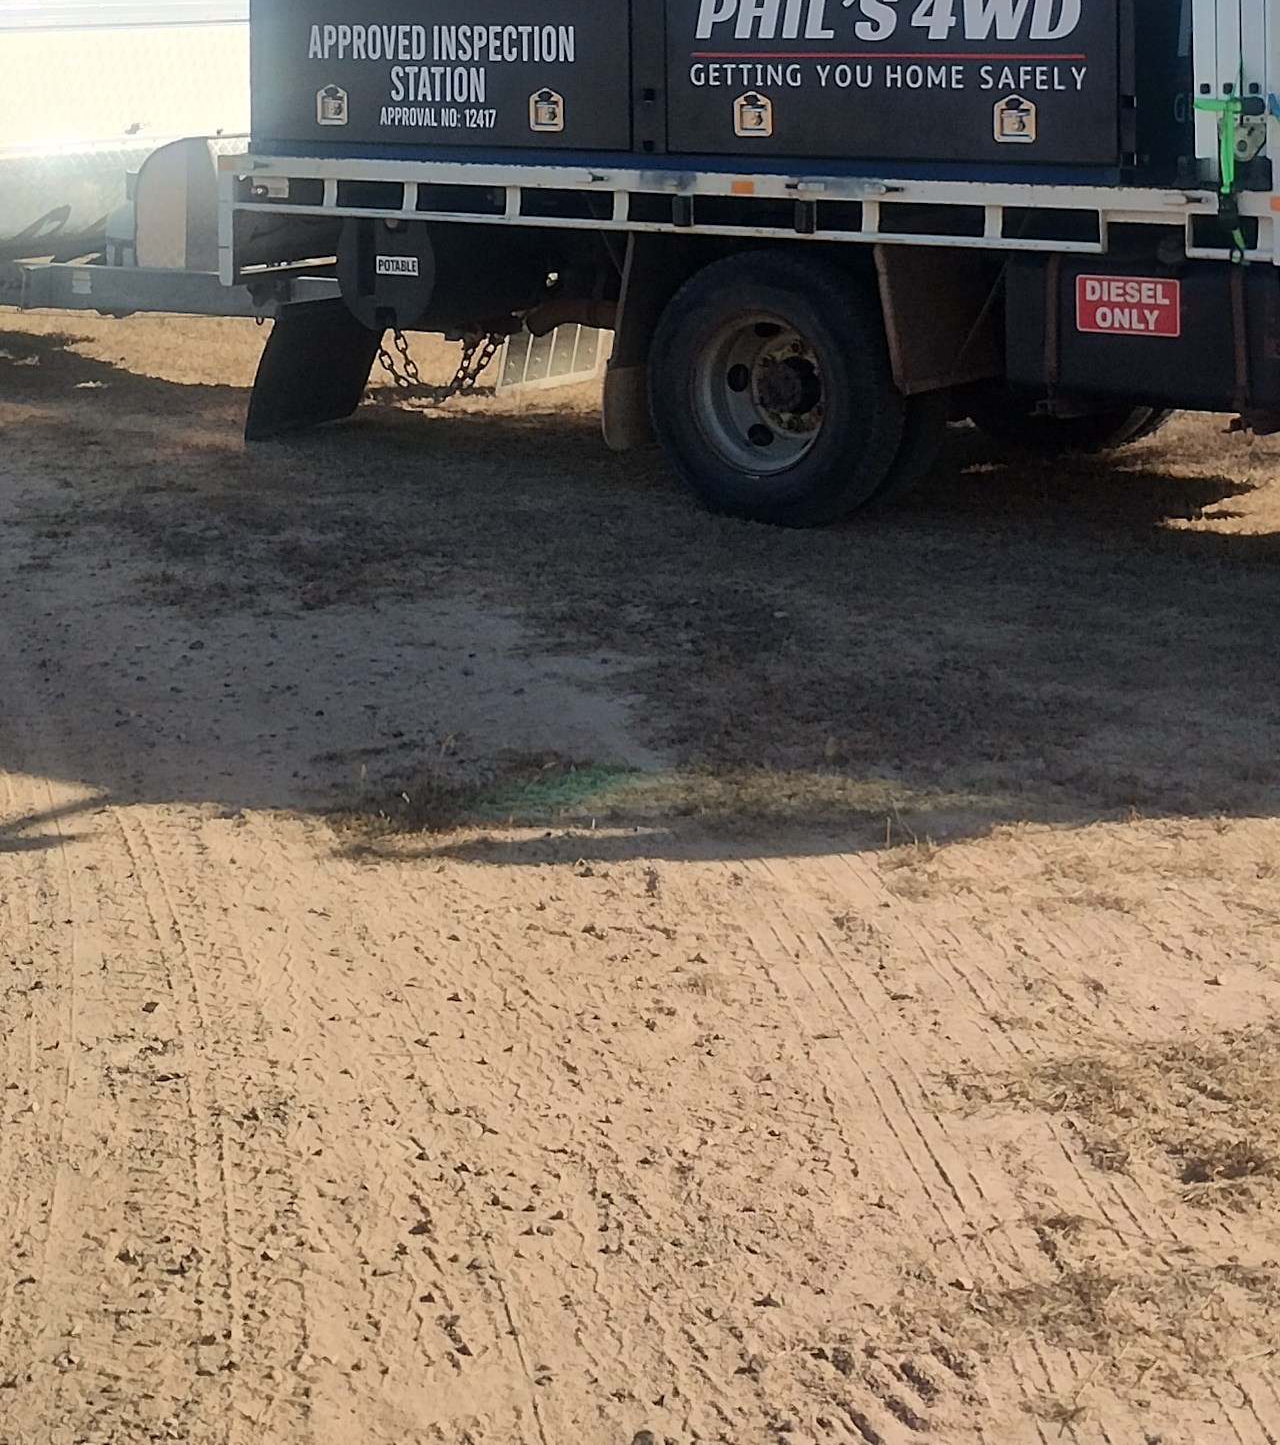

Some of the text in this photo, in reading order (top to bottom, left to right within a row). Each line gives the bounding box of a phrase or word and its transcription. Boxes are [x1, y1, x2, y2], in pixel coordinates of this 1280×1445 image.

[308, 24, 576, 63] APPROVED INSPECTION
[390, 65, 486, 103] STATION
[689, 63, 1088, 91] GETTING YOU HOME SAFELY
[380, 106, 498, 129] APPROVAL NO: 12417
[378, 259, 417, 273] POTABLE
[1085, 279, 1170, 305] DIESEL
[1095, 306, 1160, 331] ONLY
